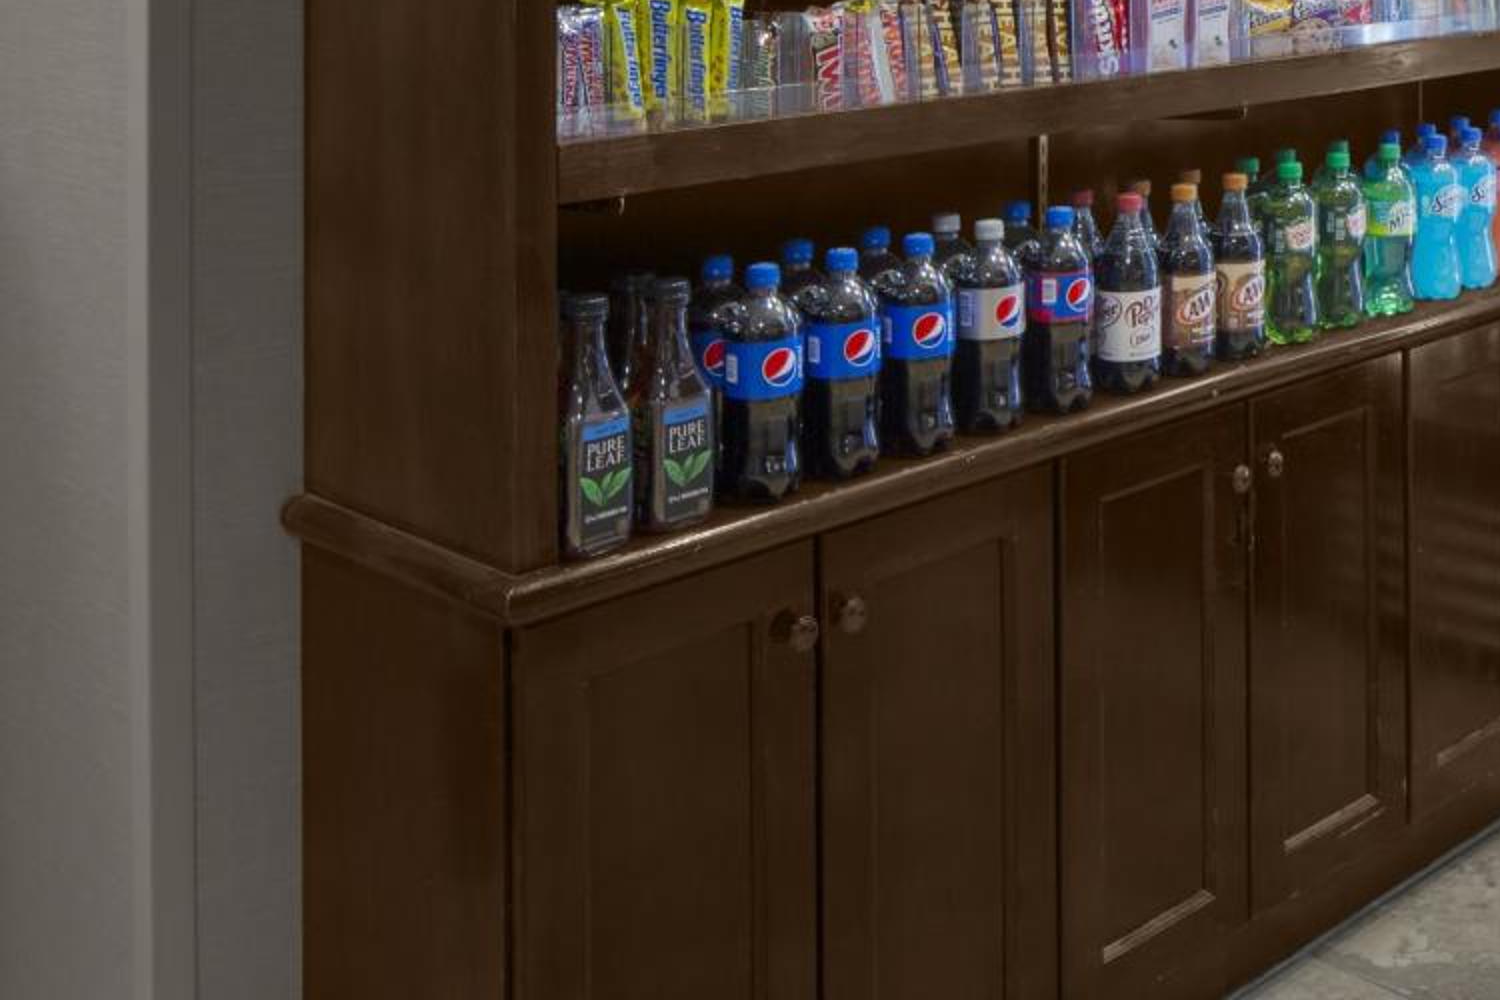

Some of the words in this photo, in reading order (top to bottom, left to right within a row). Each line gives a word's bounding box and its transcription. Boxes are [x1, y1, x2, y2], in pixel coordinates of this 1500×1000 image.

[649, 0, 672, 98] Butterfinger
[669, 420, 705, 438] PURE
[587, 435, 625, 454] PURE
[669, 434, 705, 454] LEAF
[587, 450, 625, 473] LEAF
